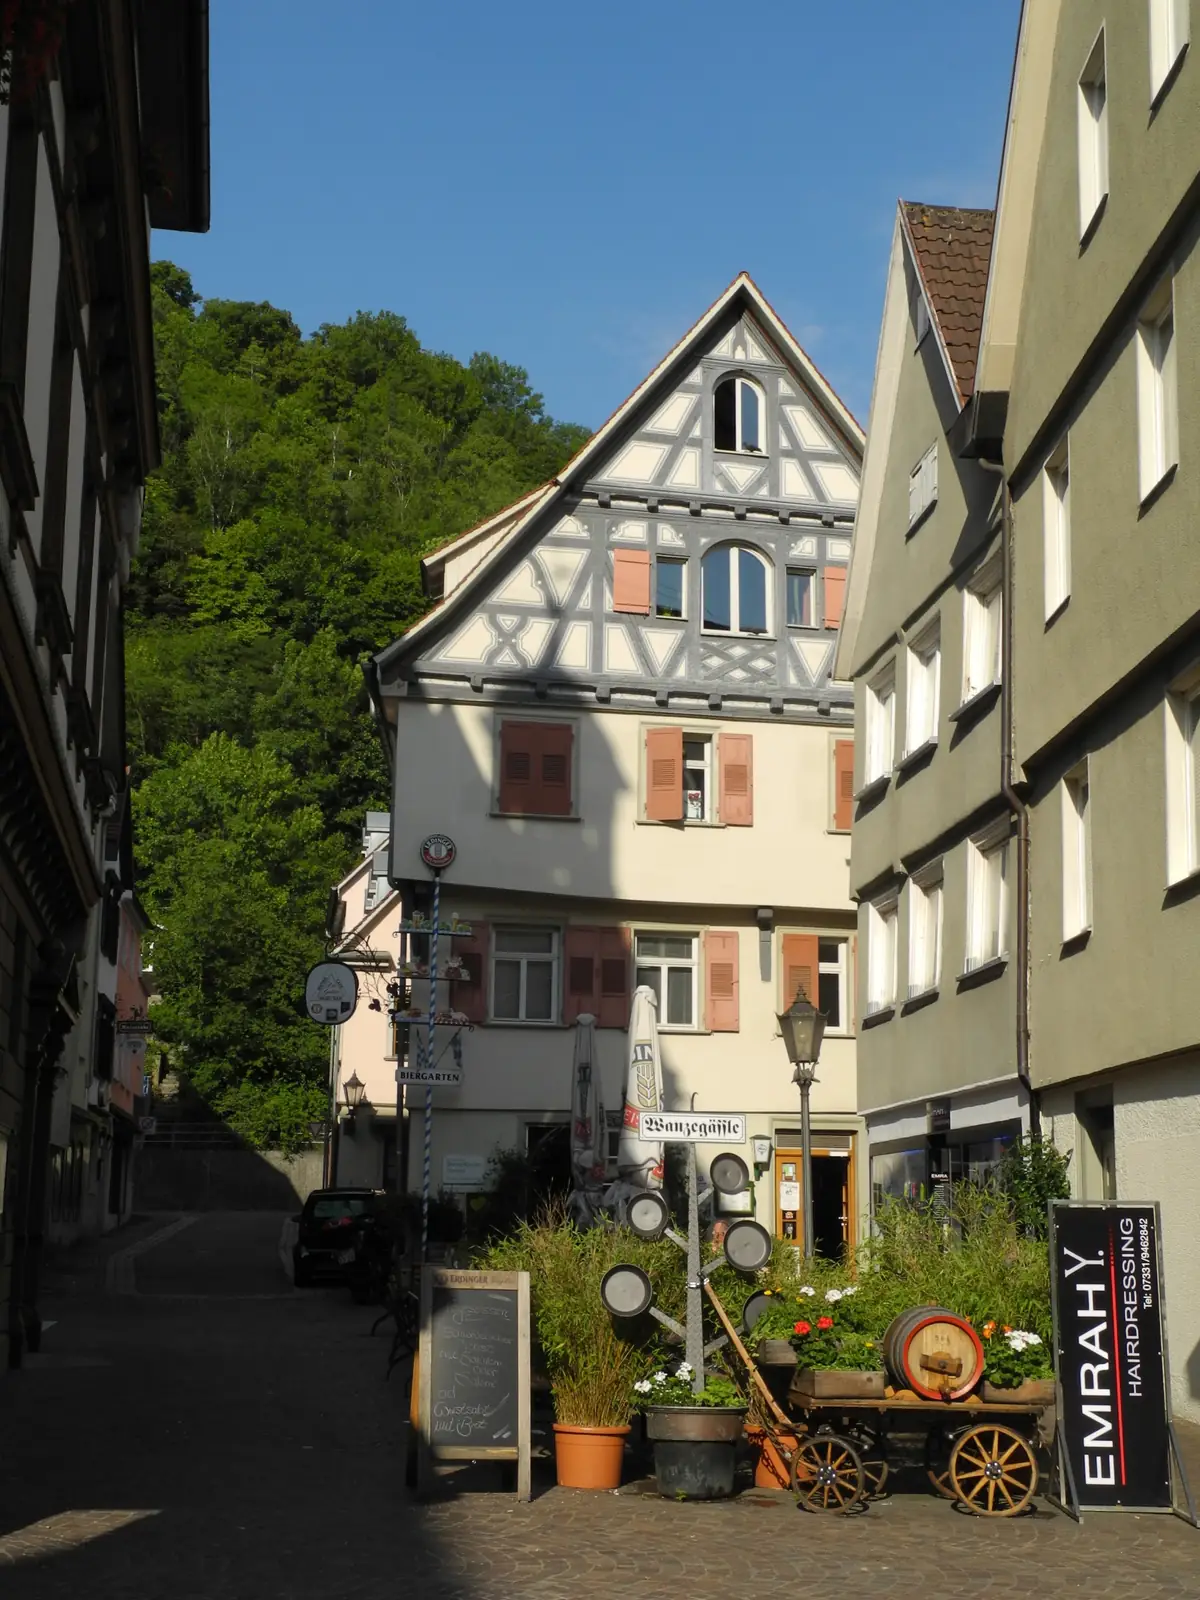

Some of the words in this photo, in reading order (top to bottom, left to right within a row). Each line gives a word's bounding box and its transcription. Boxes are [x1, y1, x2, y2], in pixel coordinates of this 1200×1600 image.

[400, 1071, 460, 1082] BIERGARTEN
[1139, 1217, 1153, 1292] 07331/9462842
[450, 1274, 488, 1284] ERDINGER
[1120, 1217, 1143, 1398] HAIRDRESSING
[1143, 1293, 1153, 1310] Tel:
